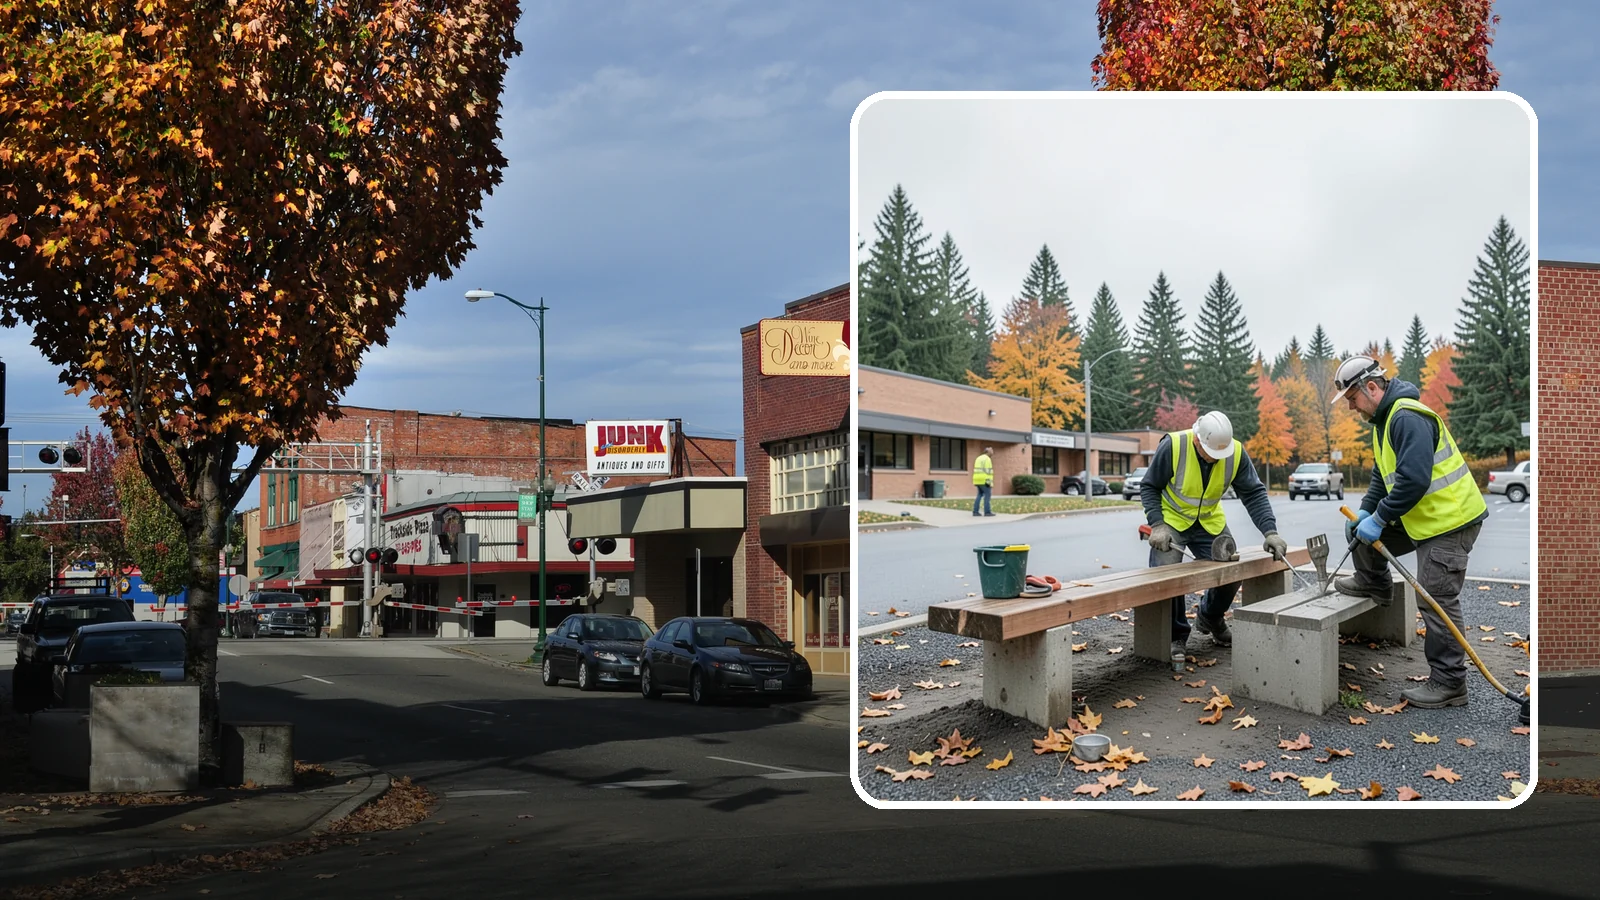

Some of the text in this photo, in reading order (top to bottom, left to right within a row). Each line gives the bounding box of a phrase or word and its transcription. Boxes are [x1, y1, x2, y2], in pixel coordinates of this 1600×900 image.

[595, 425, 664, 457] JUNK
[607, 446, 645, 454] DISORDERLY
[597, 461, 665, 470] ANTIQUES AND GIFTS
[352, 498, 364, 511] CRO
[390, 519, 429, 539] Trackside Pizza
